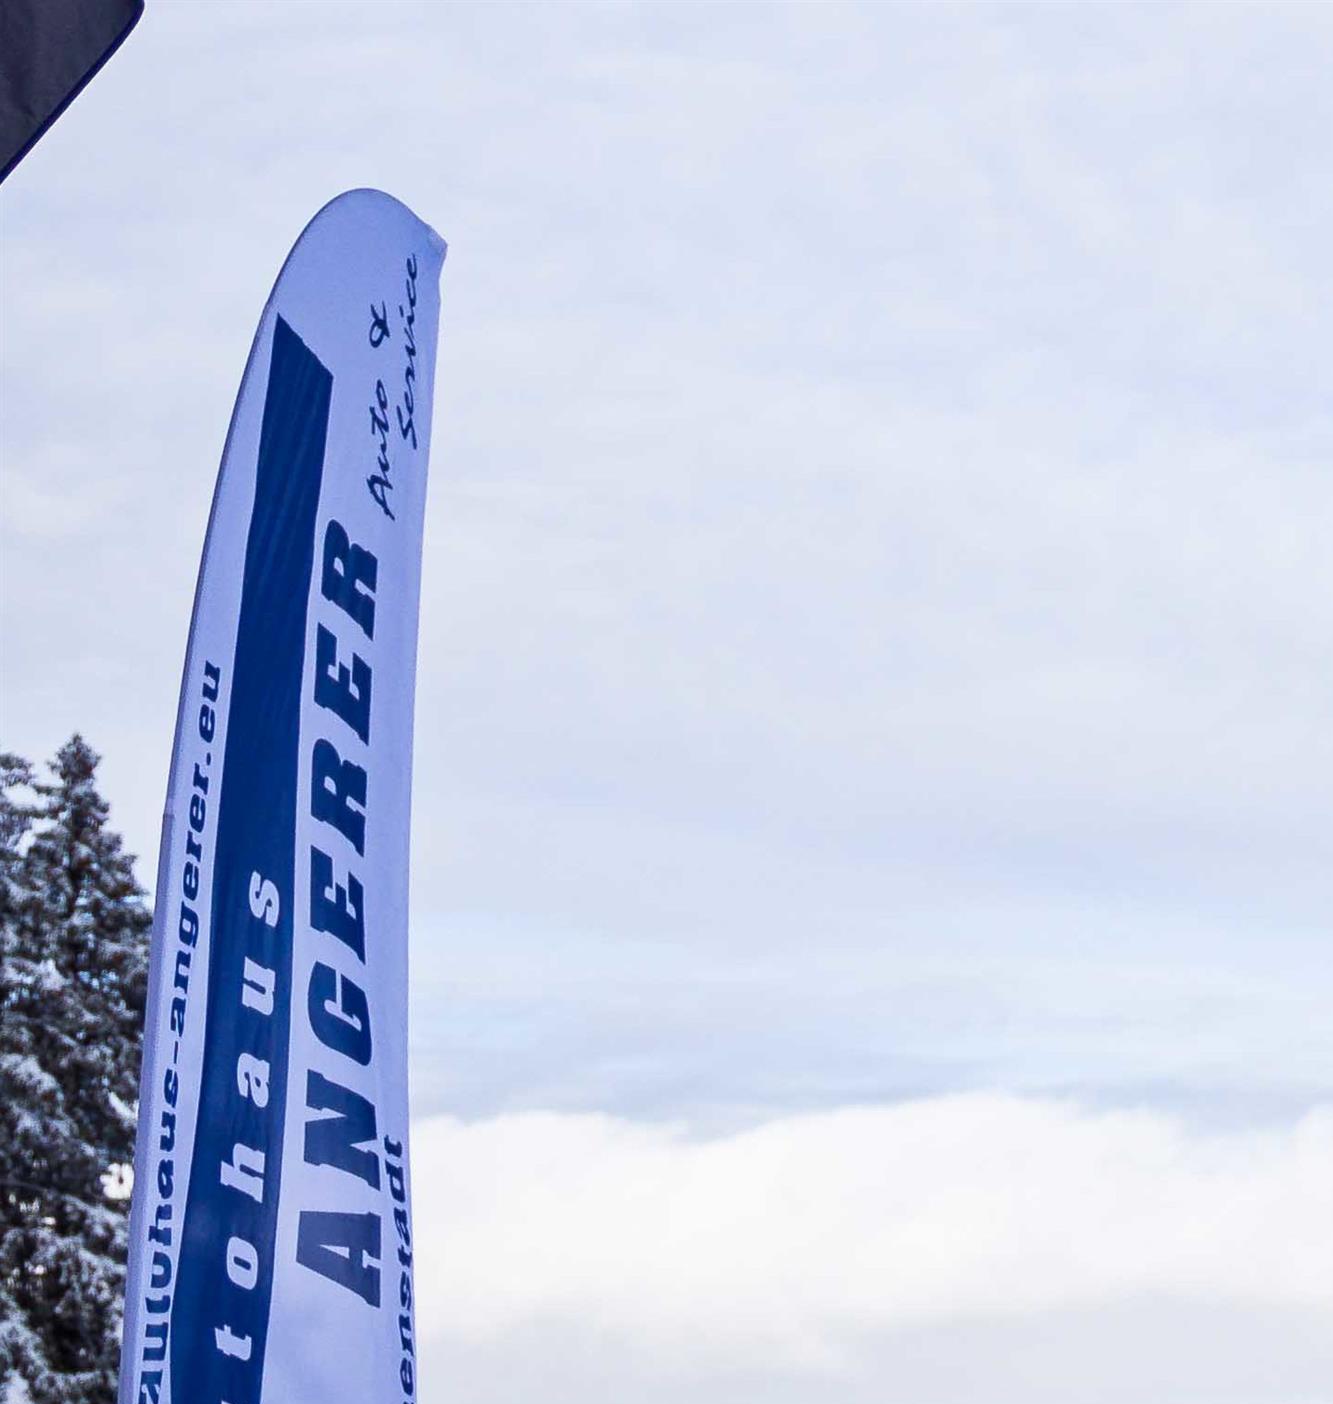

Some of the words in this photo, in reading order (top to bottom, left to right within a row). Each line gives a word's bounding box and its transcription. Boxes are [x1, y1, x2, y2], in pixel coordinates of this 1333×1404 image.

[396, 253, 418, 450] Service
[366, 379, 396, 522] Auto
[295, 518, 383, 1309] ANGERER
